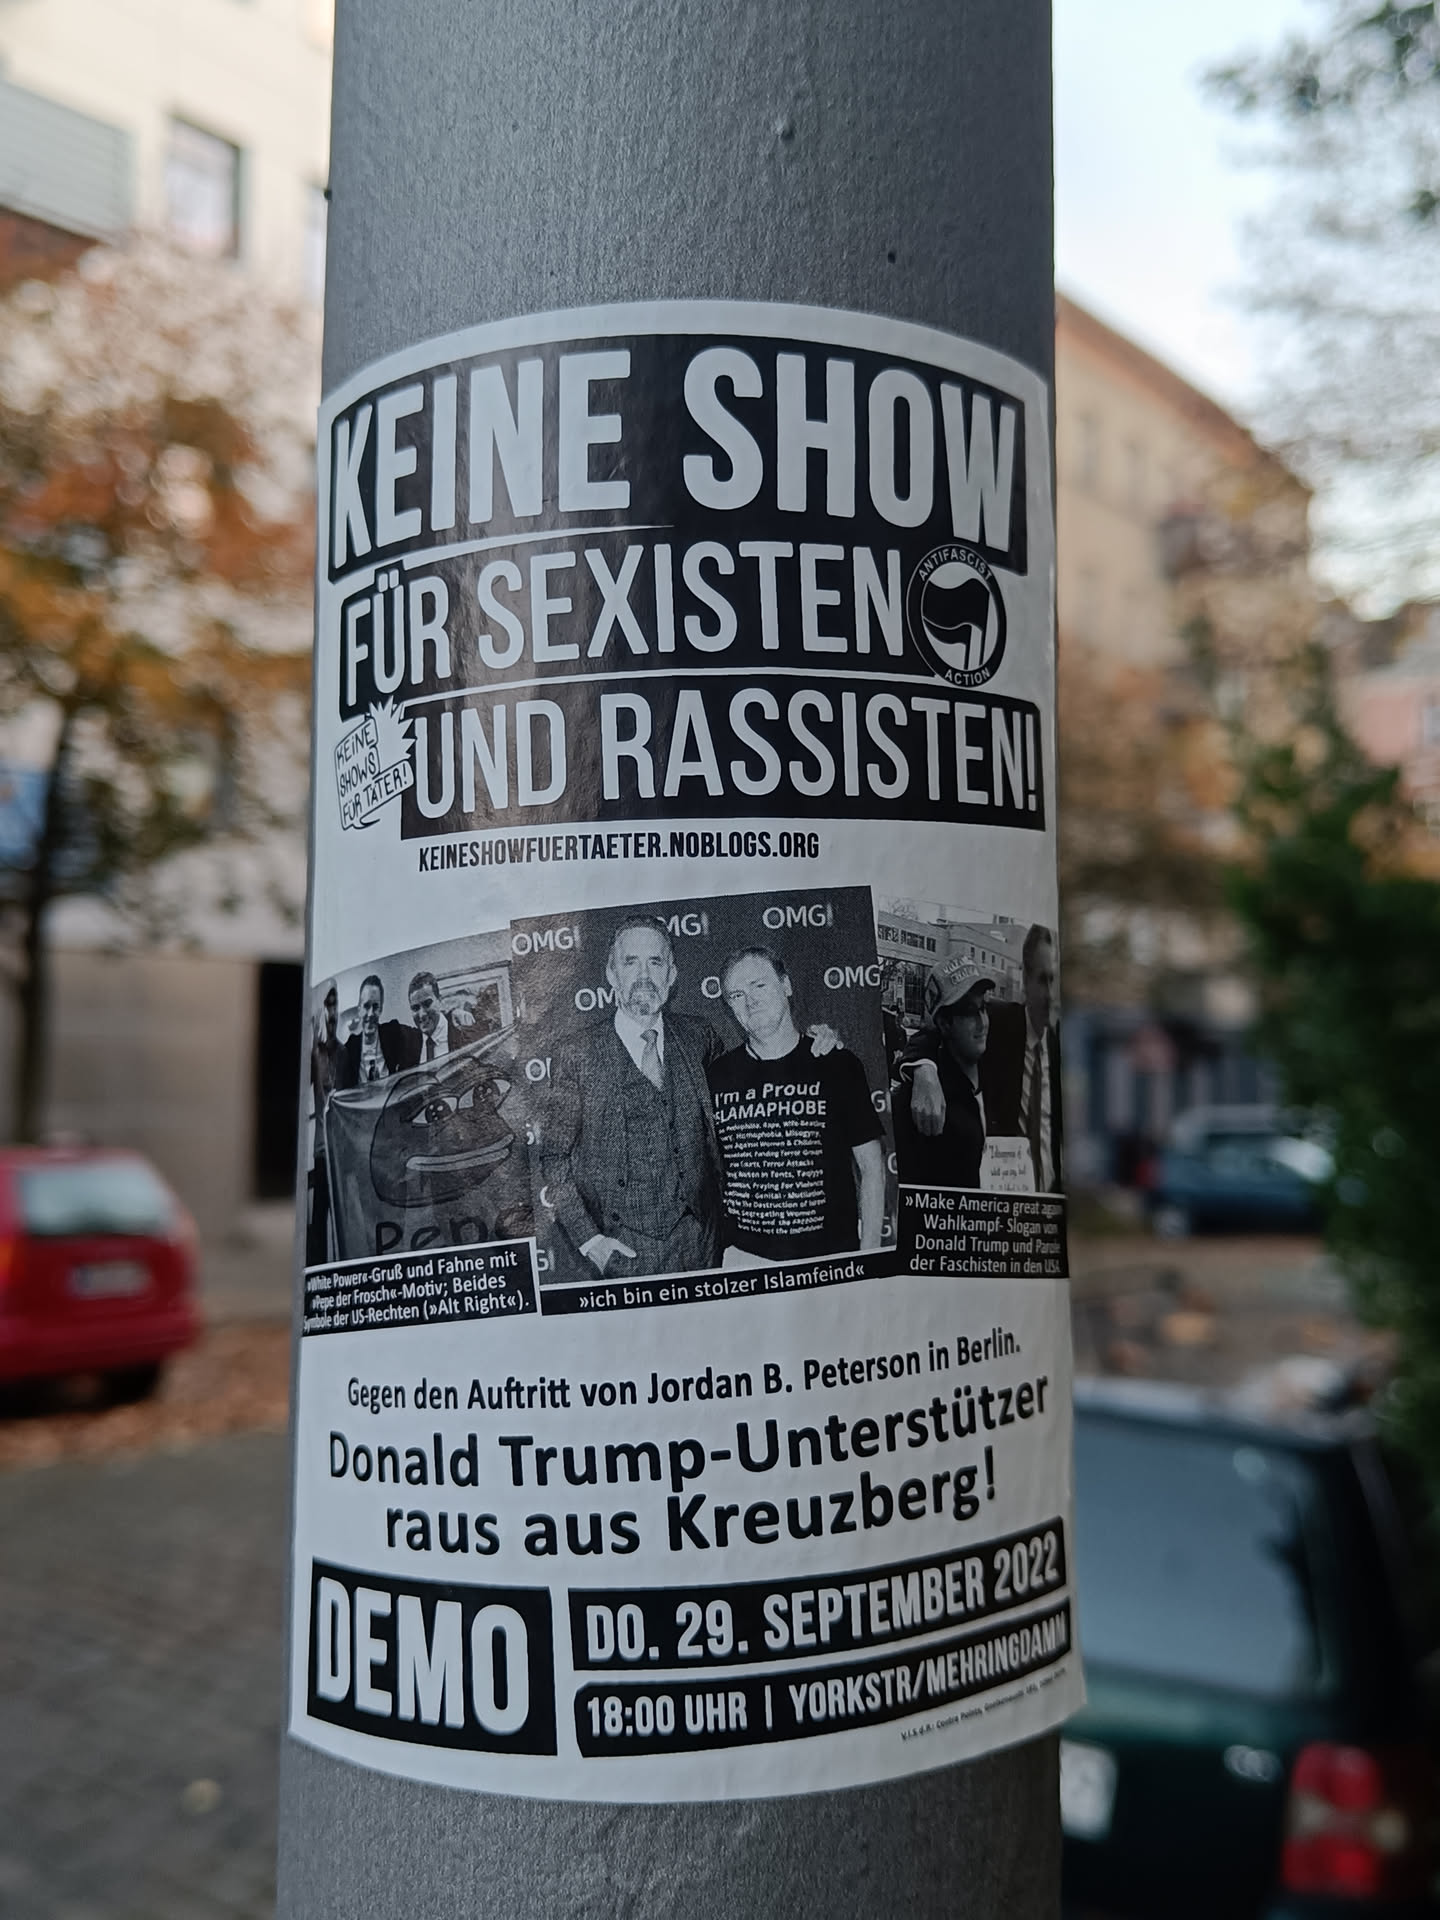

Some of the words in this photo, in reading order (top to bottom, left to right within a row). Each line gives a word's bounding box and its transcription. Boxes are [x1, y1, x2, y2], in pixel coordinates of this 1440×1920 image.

[335, 349, 631, 569] KEINE
[683, 347, 1016, 552] SHOW
[918, 548, 993, 581] ANTIFASCIST
[346, 569, 451, 707] FÜR
[477, 540, 904, 669] SEXISTEN
[944, 667, 991, 686] ACTION
[415, 699, 567, 819] UND
[600, 687, 1037, 812] RASSISTEN!
[340, 751, 377, 798] SHOWS
[342, 792, 363, 825] FÜR
[362, 762, 408, 807] TÄTER!
[419, 831, 820, 873] KEINESHOWFUERTAETER.NOBLOGS.ORG
[823, 964, 881, 989] OMG
[574, 986, 619, 1011] OM
[714, 1100, 827, 1124] SLAMAPHOBE
[715, 1091, 740, 1108] I'm
[745, 1088, 756, 1100] a
[762, 1081, 820, 1099] Proud
[958, 1195, 1010, 1214] America
[1012, 1201, 1040, 1217] great
[923, 1213, 1004, 1236] Wahlkampf-
[1007, 1217, 1042, 1238] Slogan
[909, 1254, 935, 1271] der
[939, 1255, 1007, 1273] Faschisten
[1010, 1257, 1022, 1273] in
[1023, 1258, 1042, 1274] den
[915, 1234, 966, 1252] Donald
[970, 1236, 1009, 1256] Trump
[1012, 1239, 1033, 1253] und
[407, 1260, 434, 1278] und
[437, 1257, 485, 1276] Fahne
[490, 1251, 518, 1269] mit
[335, 1292, 352, 1308] der
[452, 1273, 507, 1295] Beides
[579, 1291, 617, 1309] »ich
[623, 1286, 653, 1306] bin
[658, 1284, 689, 1302] ein
[695, 1275, 759, 1298] stolzer
[764, 1261, 866, 1291] Islamfeind«
[333, 1311, 349, 1327] der
[351, 1304, 420, 1326] US-Rechten
[348, 1376, 406, 1415] Gegen
[414, 1377, 459, 1410] den
[467, 1375, 571, 1410] Auftritt
[580, 1379, 638, 1407] von
[648, 1366, 752, 1404] Jordan
[763, 1362, 793, 1395] B.
[804, 1351, 921, 1390] Peterson
[928, 1341, 950, 1372] in
[957, 1327, 1021, 1366] Berlin.
[330, 1430, 479, 1487] Donald
[499, 1375, 1048, 1493] Trump-Unterstützer
[386, 1507, 501, 1556] raus
[524, 1510, 641, 1557] aus
[667, 1445, 995, 1551] Kreuzberg!
[586, 1602, 660, 1663] DO.
[676, 1599, 749, 1660] 29.
[762, 1556, 985, 1653] SEPTEMBER
[993, 1530, 1059, 1602] 2022
[316, 1576, 530, 1736] DEMO
[587, 1695, 675, 1738] 18:00
[685, 1690, 748, 1735] UHR
[788, 1611, 1067, 1723] YORKSTR/MEHRINGDAMM
